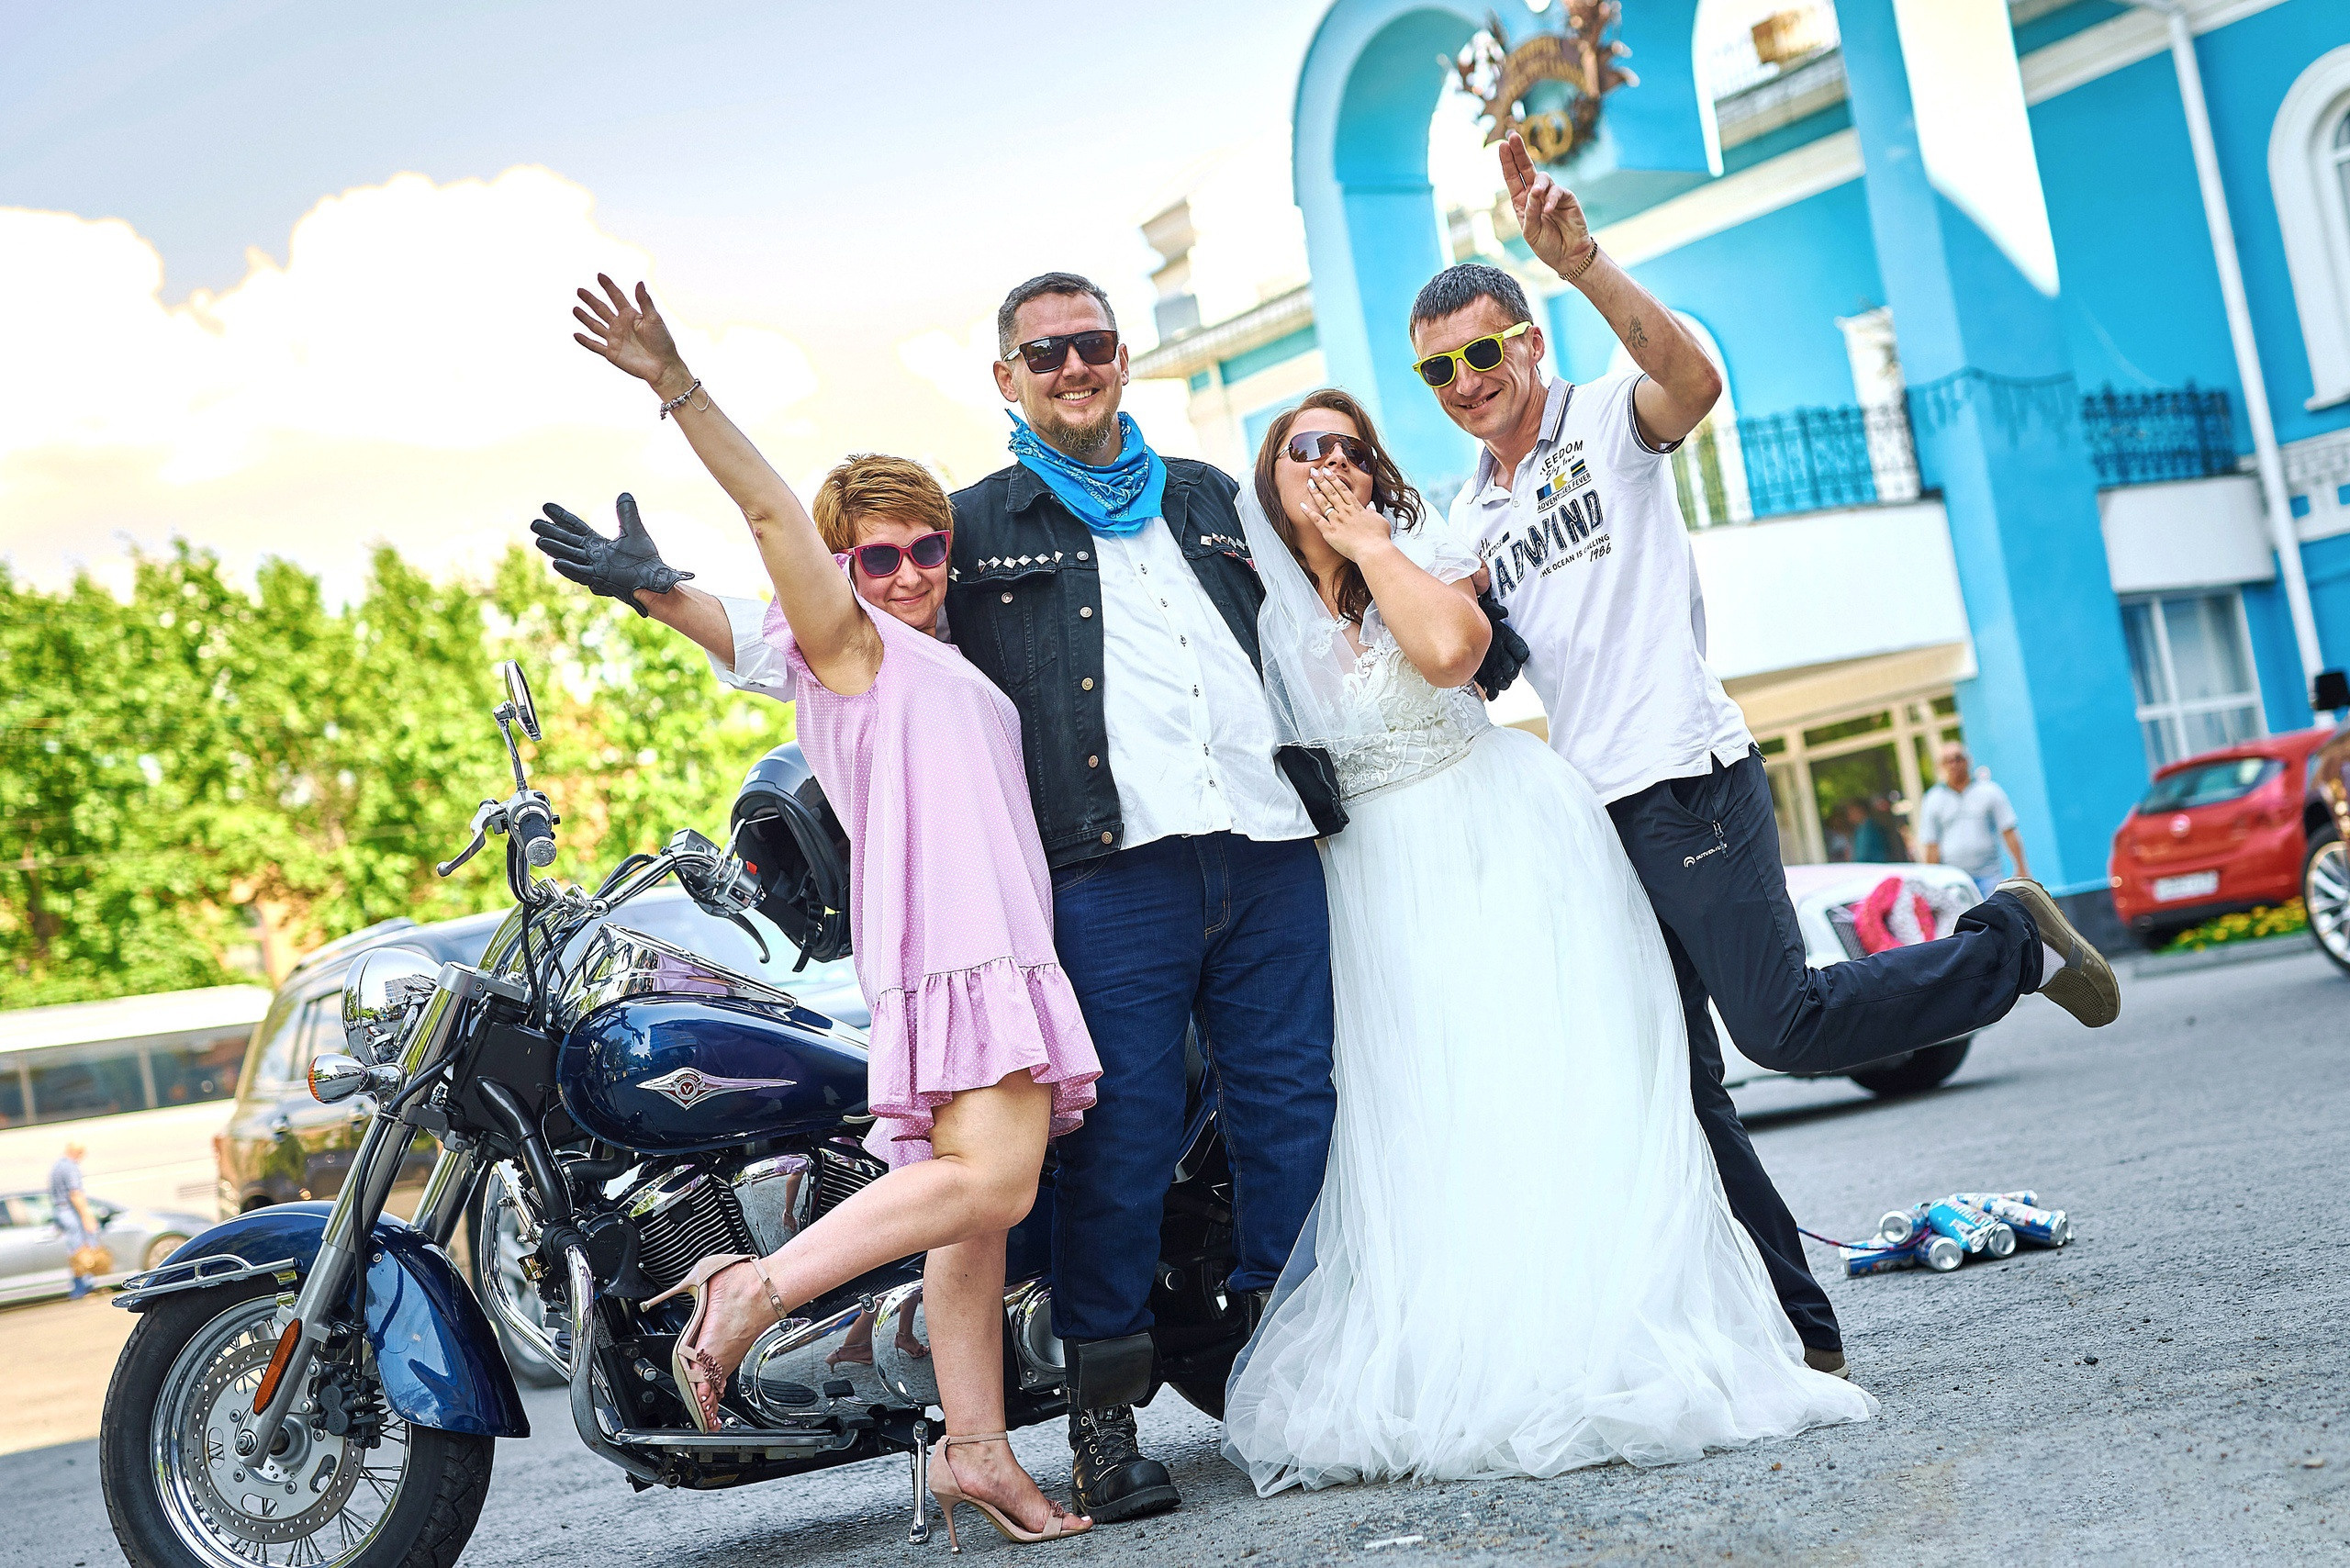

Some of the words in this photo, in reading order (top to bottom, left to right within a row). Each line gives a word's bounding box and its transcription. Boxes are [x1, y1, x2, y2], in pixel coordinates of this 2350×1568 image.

[1540, 440, 1583, 476] EEDOM
[1538, 485, 1572, 511] ADVENTES
[1572, 472, 1592, 487] FEVER
[1540, 566, 1552, 578] HE
[1552, 554, 1575, 571] OCEAN
[1576, 550, 1583, 559] IS
[1590, 543, 1612, 563] 1986
